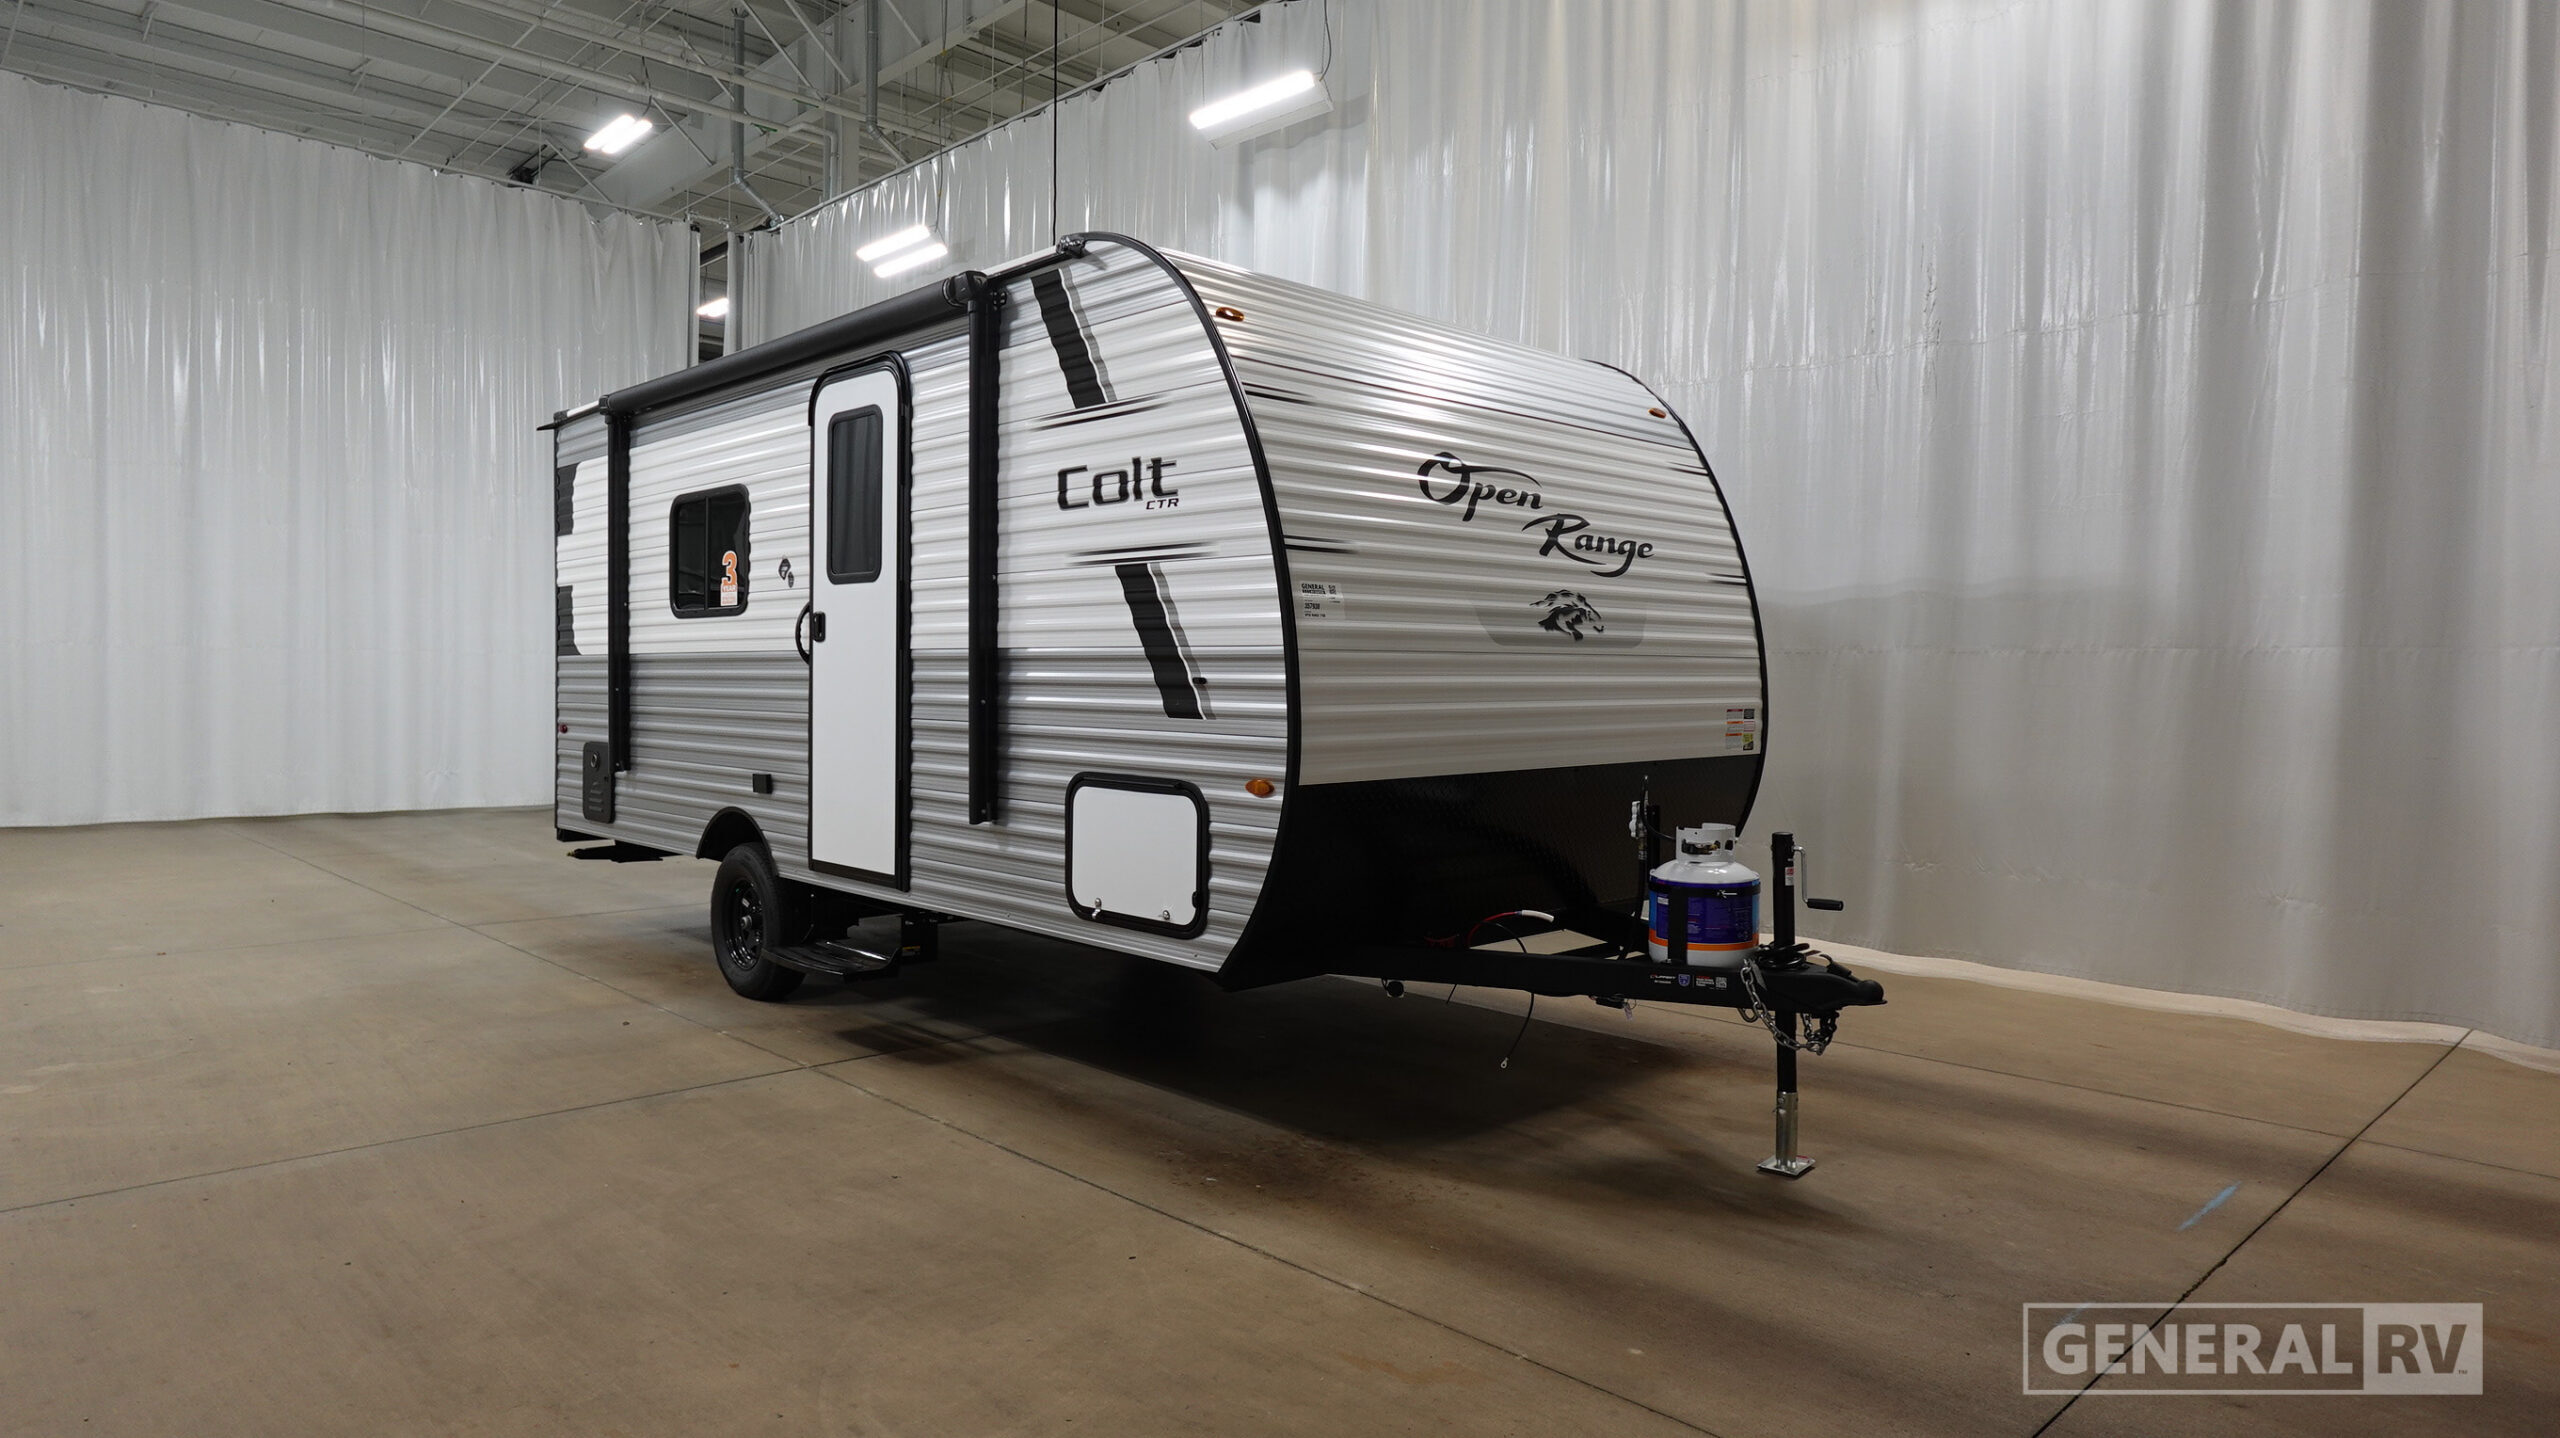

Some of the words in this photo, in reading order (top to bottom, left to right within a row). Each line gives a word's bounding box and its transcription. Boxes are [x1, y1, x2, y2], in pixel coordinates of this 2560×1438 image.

[1057, 456, 1179, 511] Colt
[1145, 498, 1180, 510] CTR
[1417, 451, 1543, 522] Open
[722, 551, 737, 586] 3
[1521, 513, 1656, 578] Range
